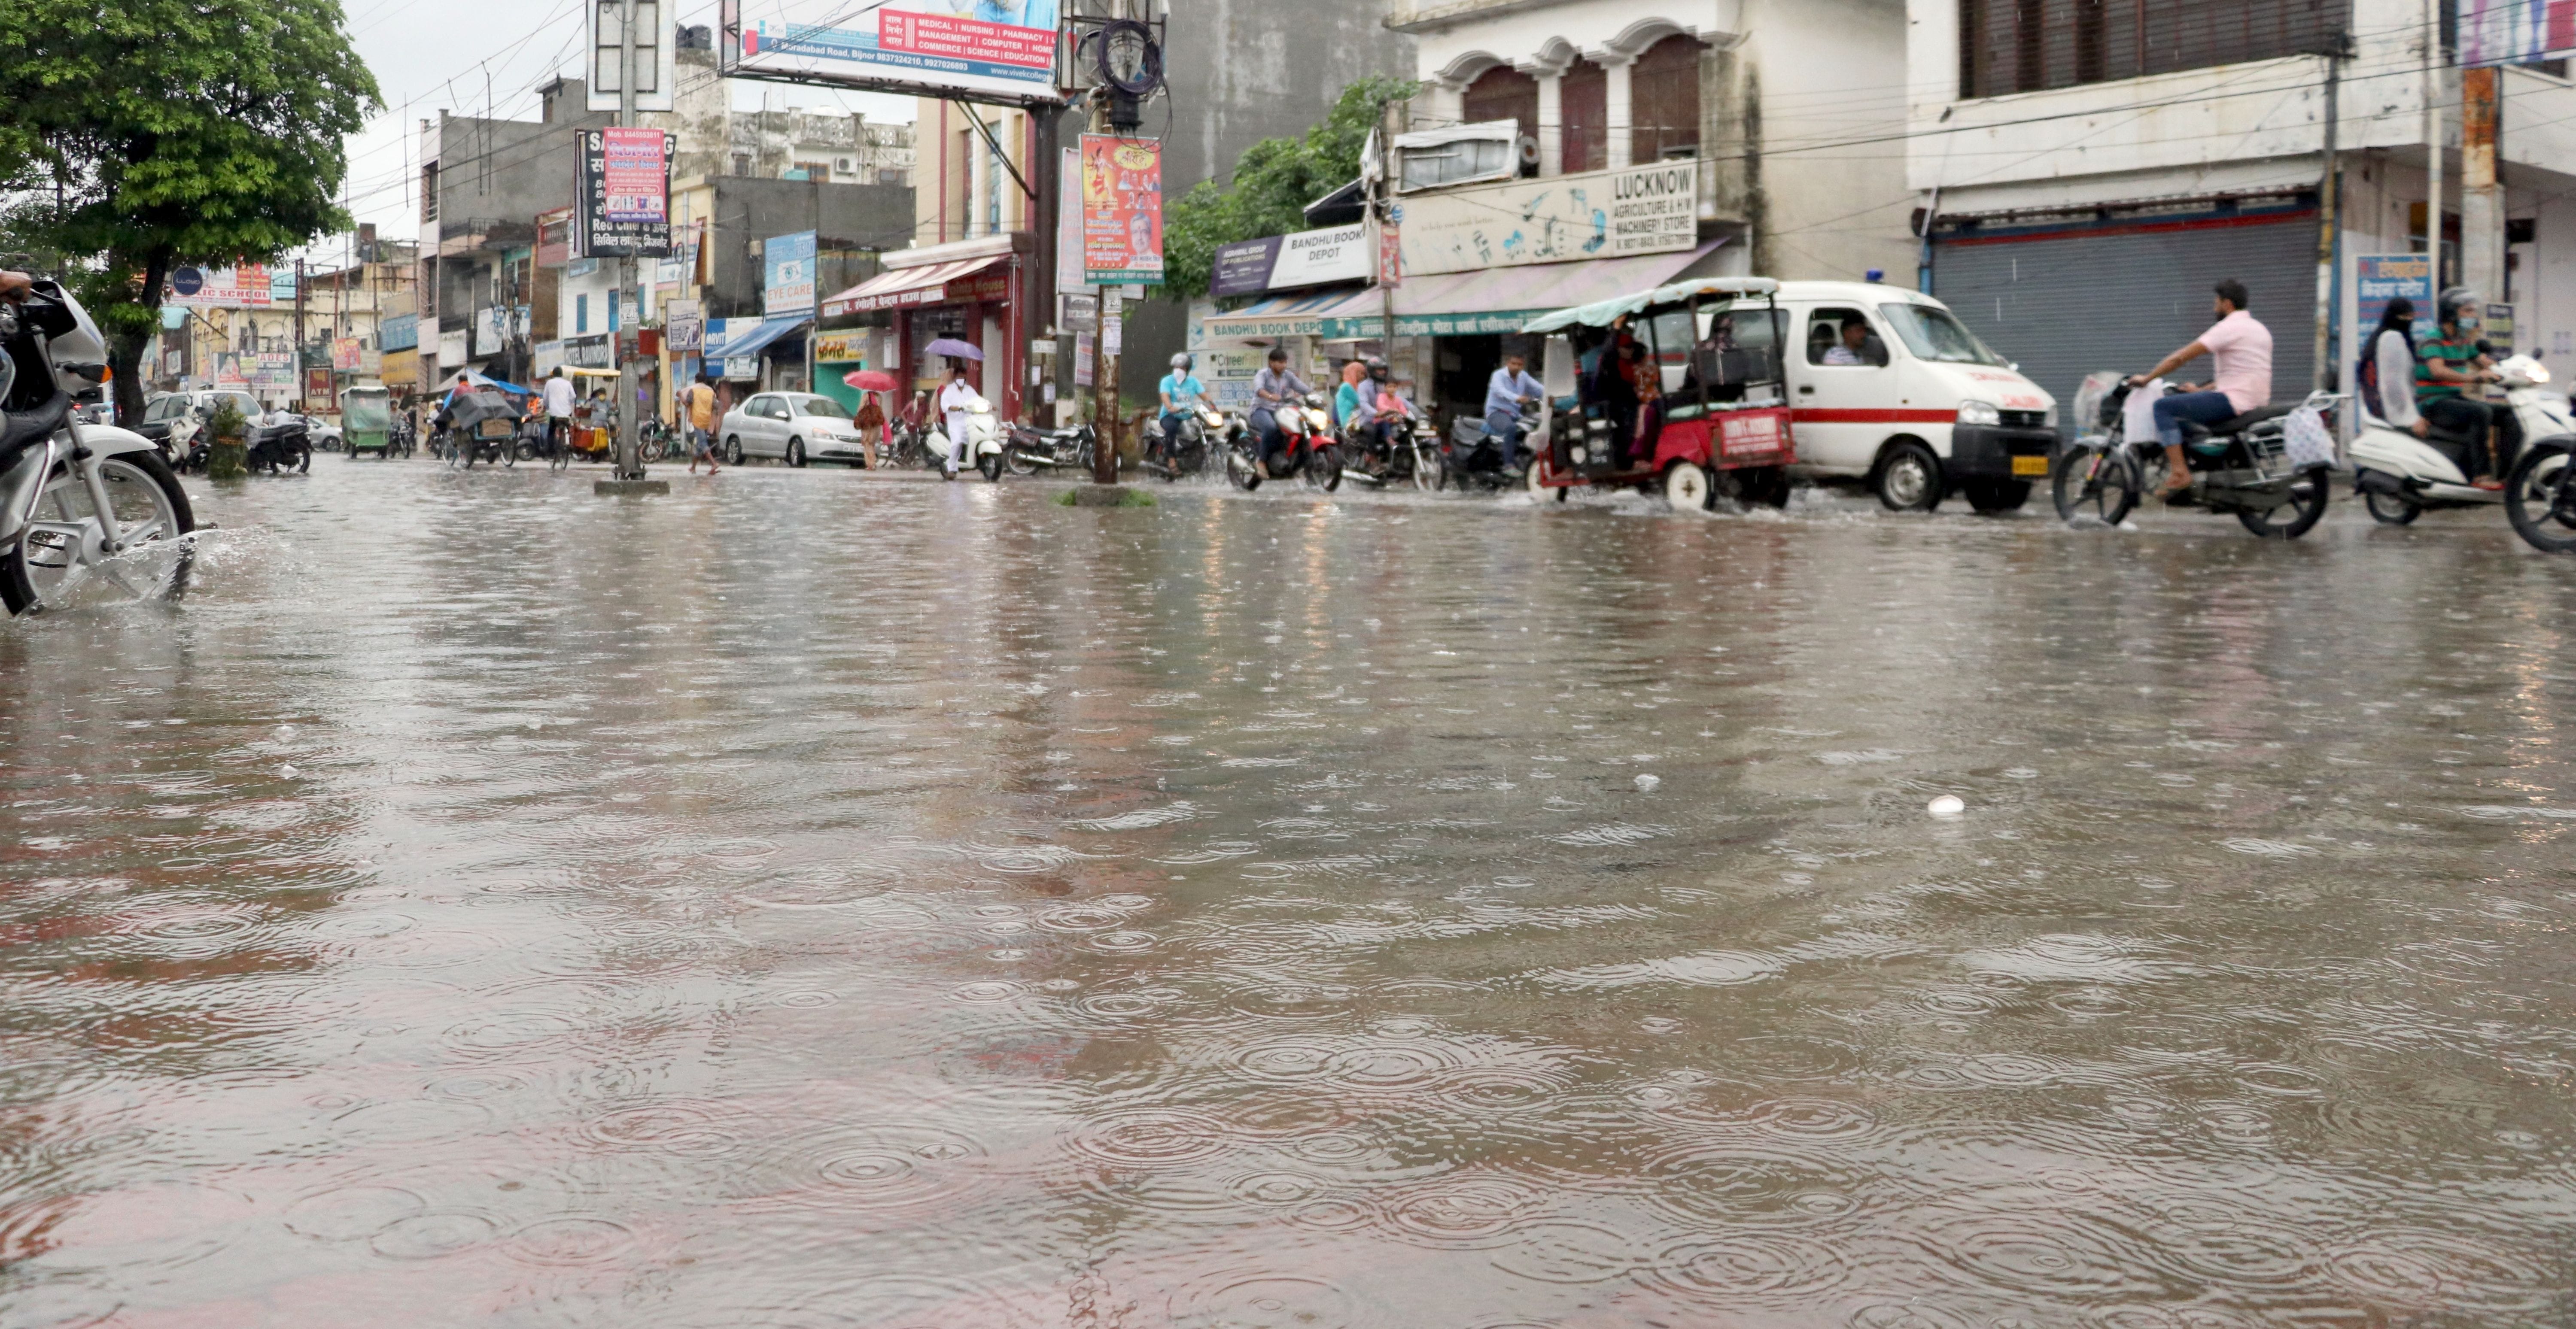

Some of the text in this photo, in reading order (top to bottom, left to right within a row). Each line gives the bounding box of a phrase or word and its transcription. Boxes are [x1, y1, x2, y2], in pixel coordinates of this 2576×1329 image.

[885, 15, 903, 24] आत्म
[886, 24, 903, 36] निर्भर
[918, 18, 952, 30] MEDICAL
[961, 24, 994, 35] NURSING
[1003, 30, 1043, 42] PHARMACY
[886, 36, 903, 46] भारत
[918, 30, 1053, 53] MANAGEMENT COMPUTER HOME
[781, 42, 968, 70] Moradabad Road, Bijnor 9837324210, 9927026893
[918, 41, 1045, 63] COMMERCE SCIENCE EDUCATION
[1615, 168, 1692, 200] LUCKNOW
[1614, 200, 1667, 218] AGRICULTURE
[1670, 199, 1674, 213] &
[1616, 215, 1690, 236] MACHINERY STORE
[593, 233, 619, 246] सिविल
[1291, 229, 1363, 249] BANDHU BOOK
[1308, 247, 1341, 261] DEPOT
[219, 290, 268, 298] SCHOOL
[767, 283, 812, 300] EYE CARE
[1213, 320, 1323, 336] BANDHU BOOK DEPO
[260, 353, 289, 362] ADES
[564, 346, 580, 365] HOTEL
[310, 388, 330, 396] ATM
